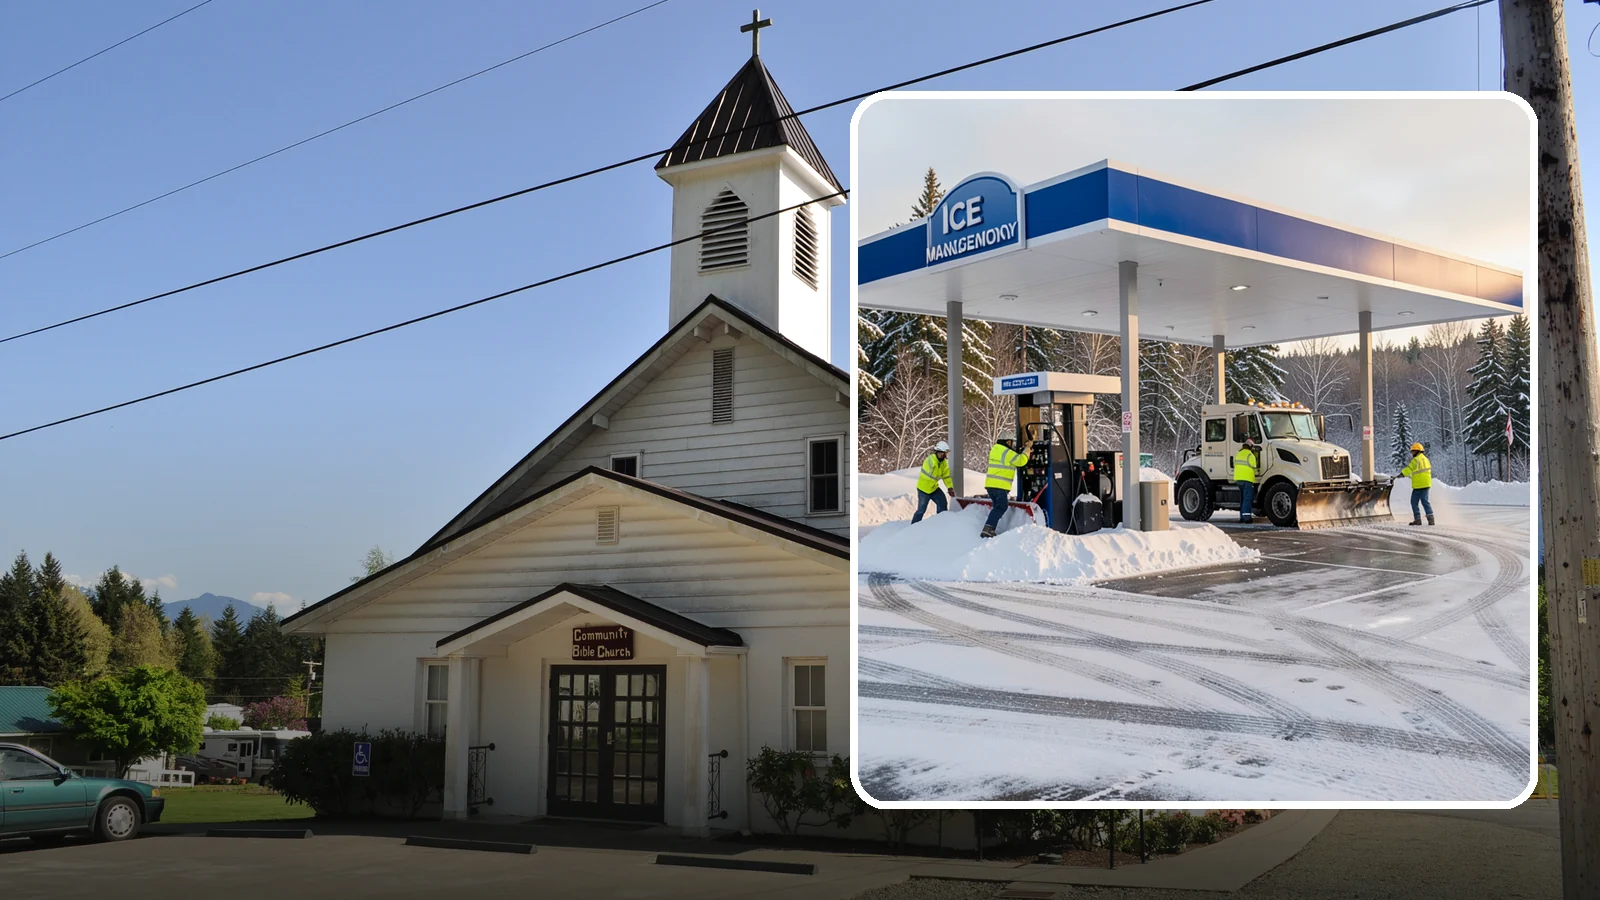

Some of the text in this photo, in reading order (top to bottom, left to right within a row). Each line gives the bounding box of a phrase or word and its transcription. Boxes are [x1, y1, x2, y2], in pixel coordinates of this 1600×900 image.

[942, 196, 983, 235] ICE
[574, 627, 628, 641] Community
[573, 645, 631, 658] Bible Church
